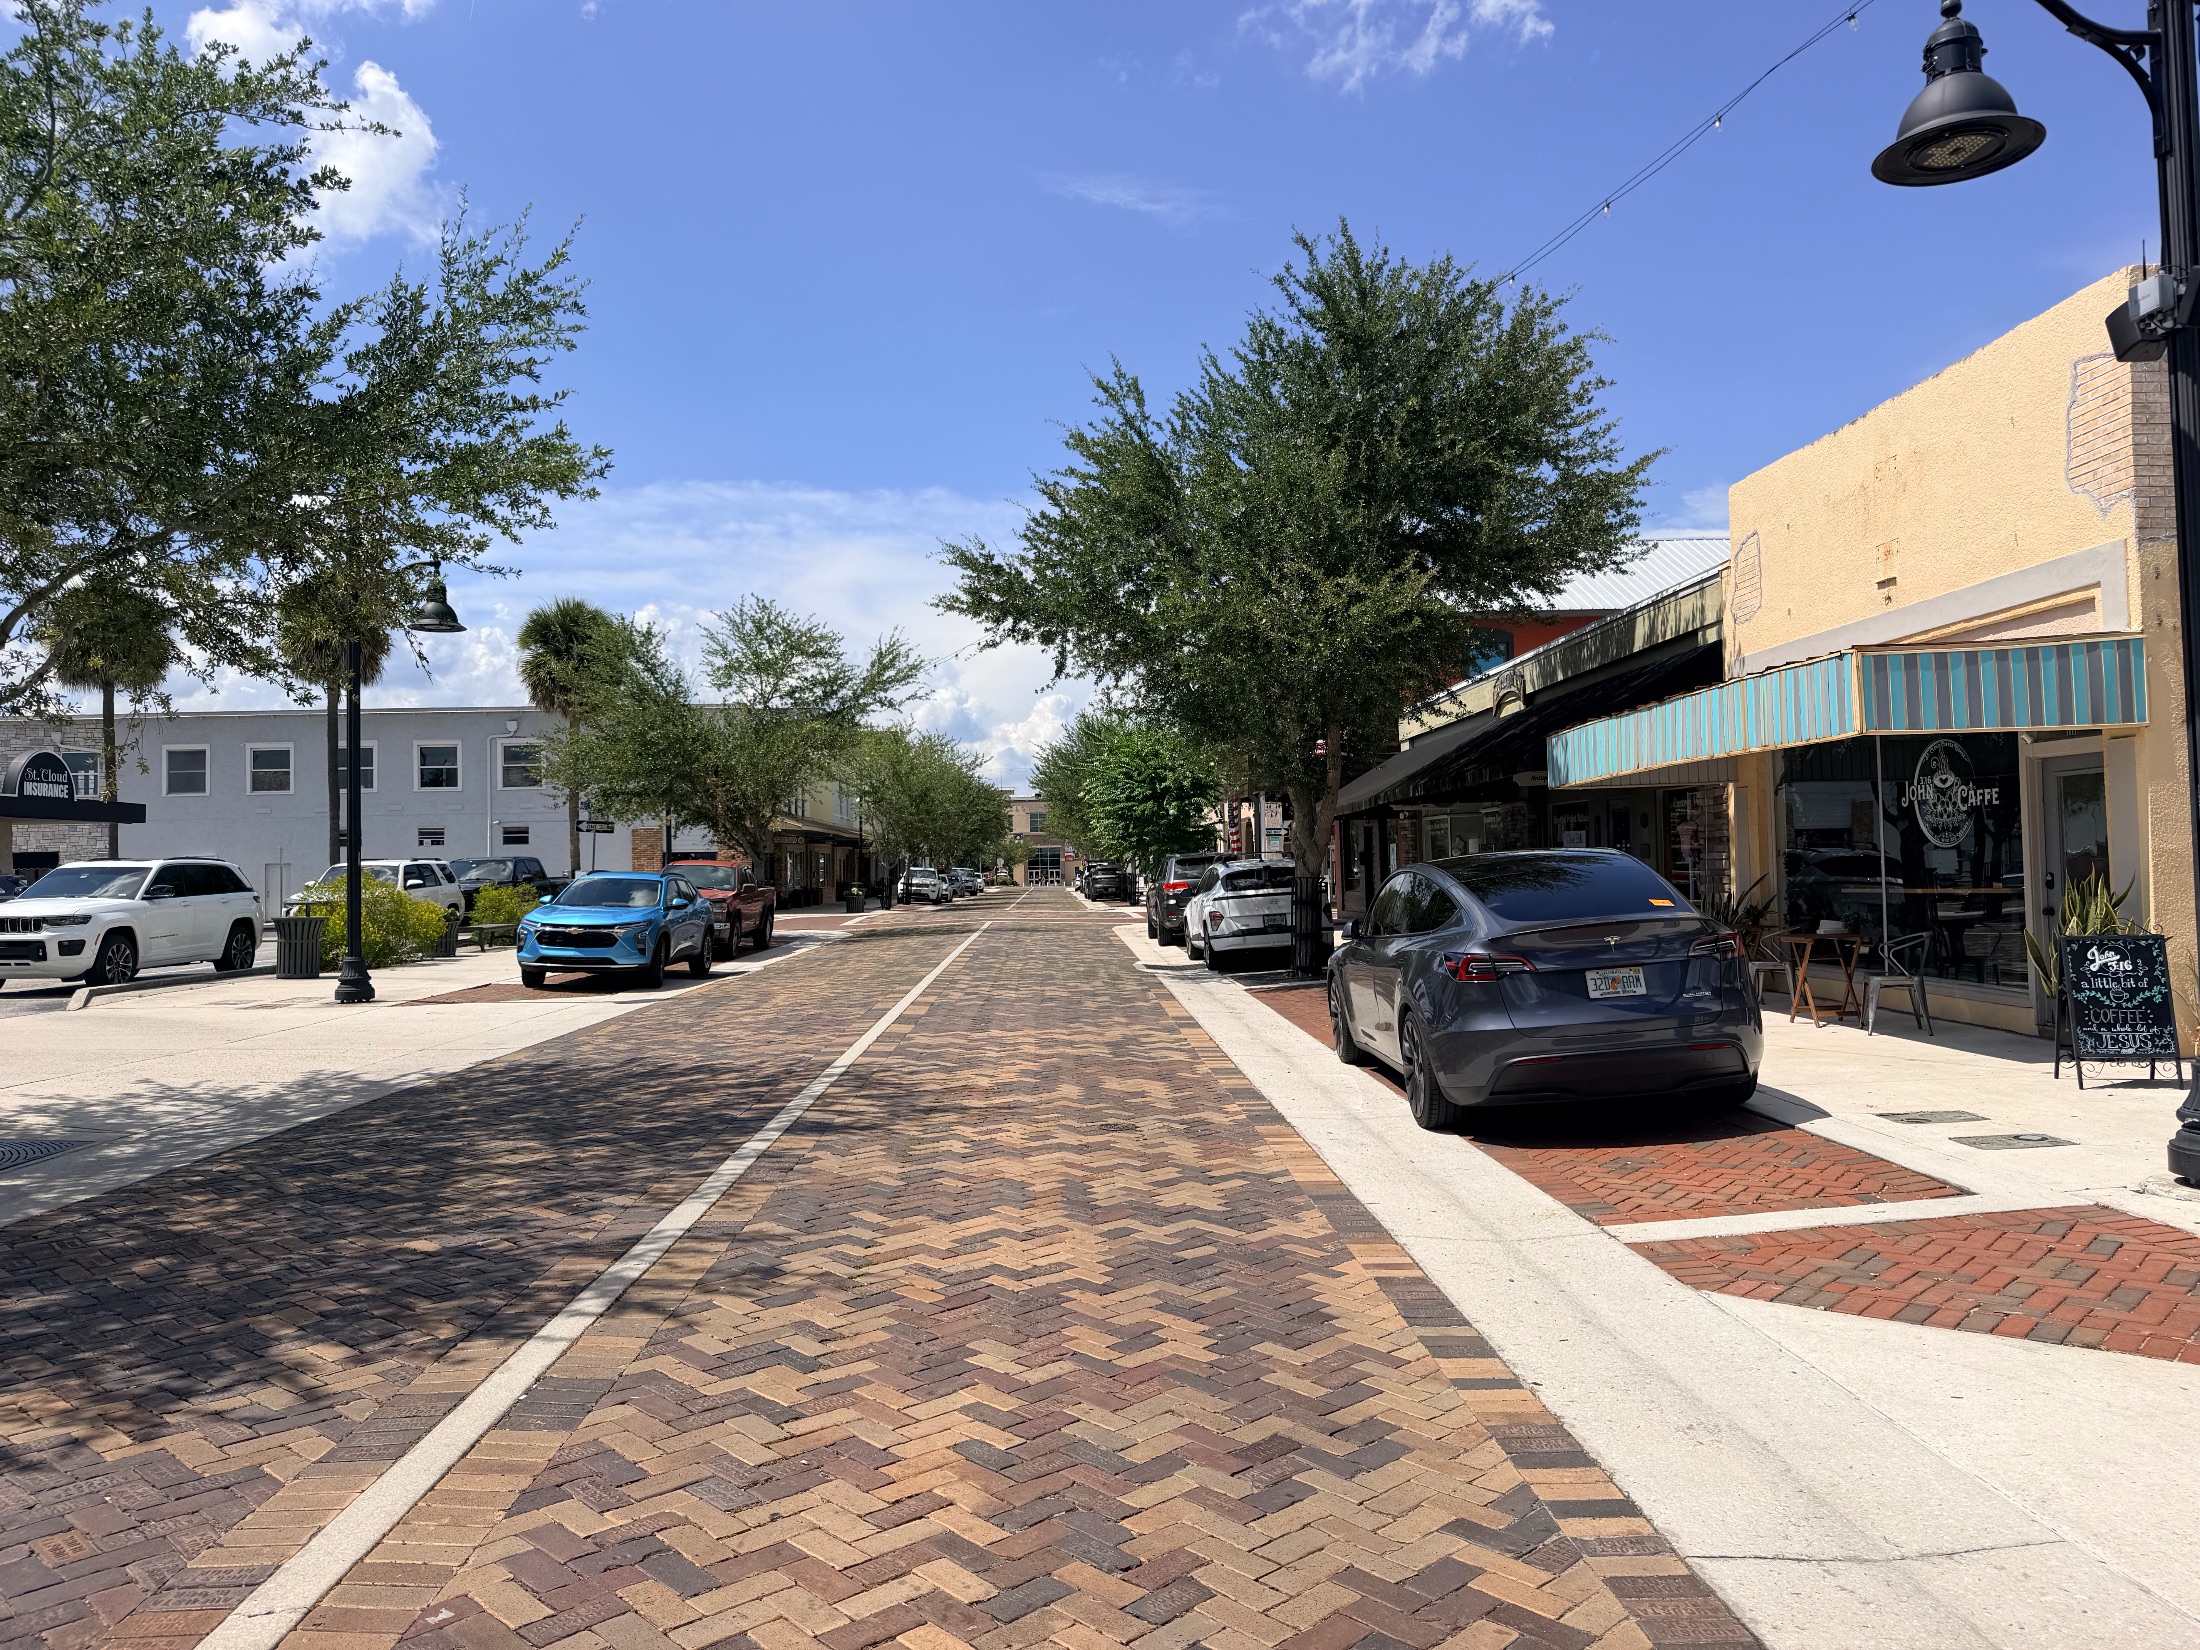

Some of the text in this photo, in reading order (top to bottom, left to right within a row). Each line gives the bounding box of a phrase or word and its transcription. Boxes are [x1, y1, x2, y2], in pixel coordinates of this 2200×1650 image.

[25, 767, 68, 783] St. Cloud
[23, 781, 69, 798] INSURANCE
[1901, 781, 2000, 811] JOHN CAFFE
[2087, 945, 2121, 971] John
[2107, 960, 2133, 971] 3:16
[2091, 978, 2117, 989] little
[2121, 978, 2136, 988] bit
[2138, 978, 2149, 988] of
[2090, 1008, 2147, 1024] COFFEE
[2083, 1024, 2097, 1032] and
[2111, 1024, 2133, 1032] whole
[2136, 1024, 2147, 1032] lot
[2096, 1034, 2152, 1049] JESUS
